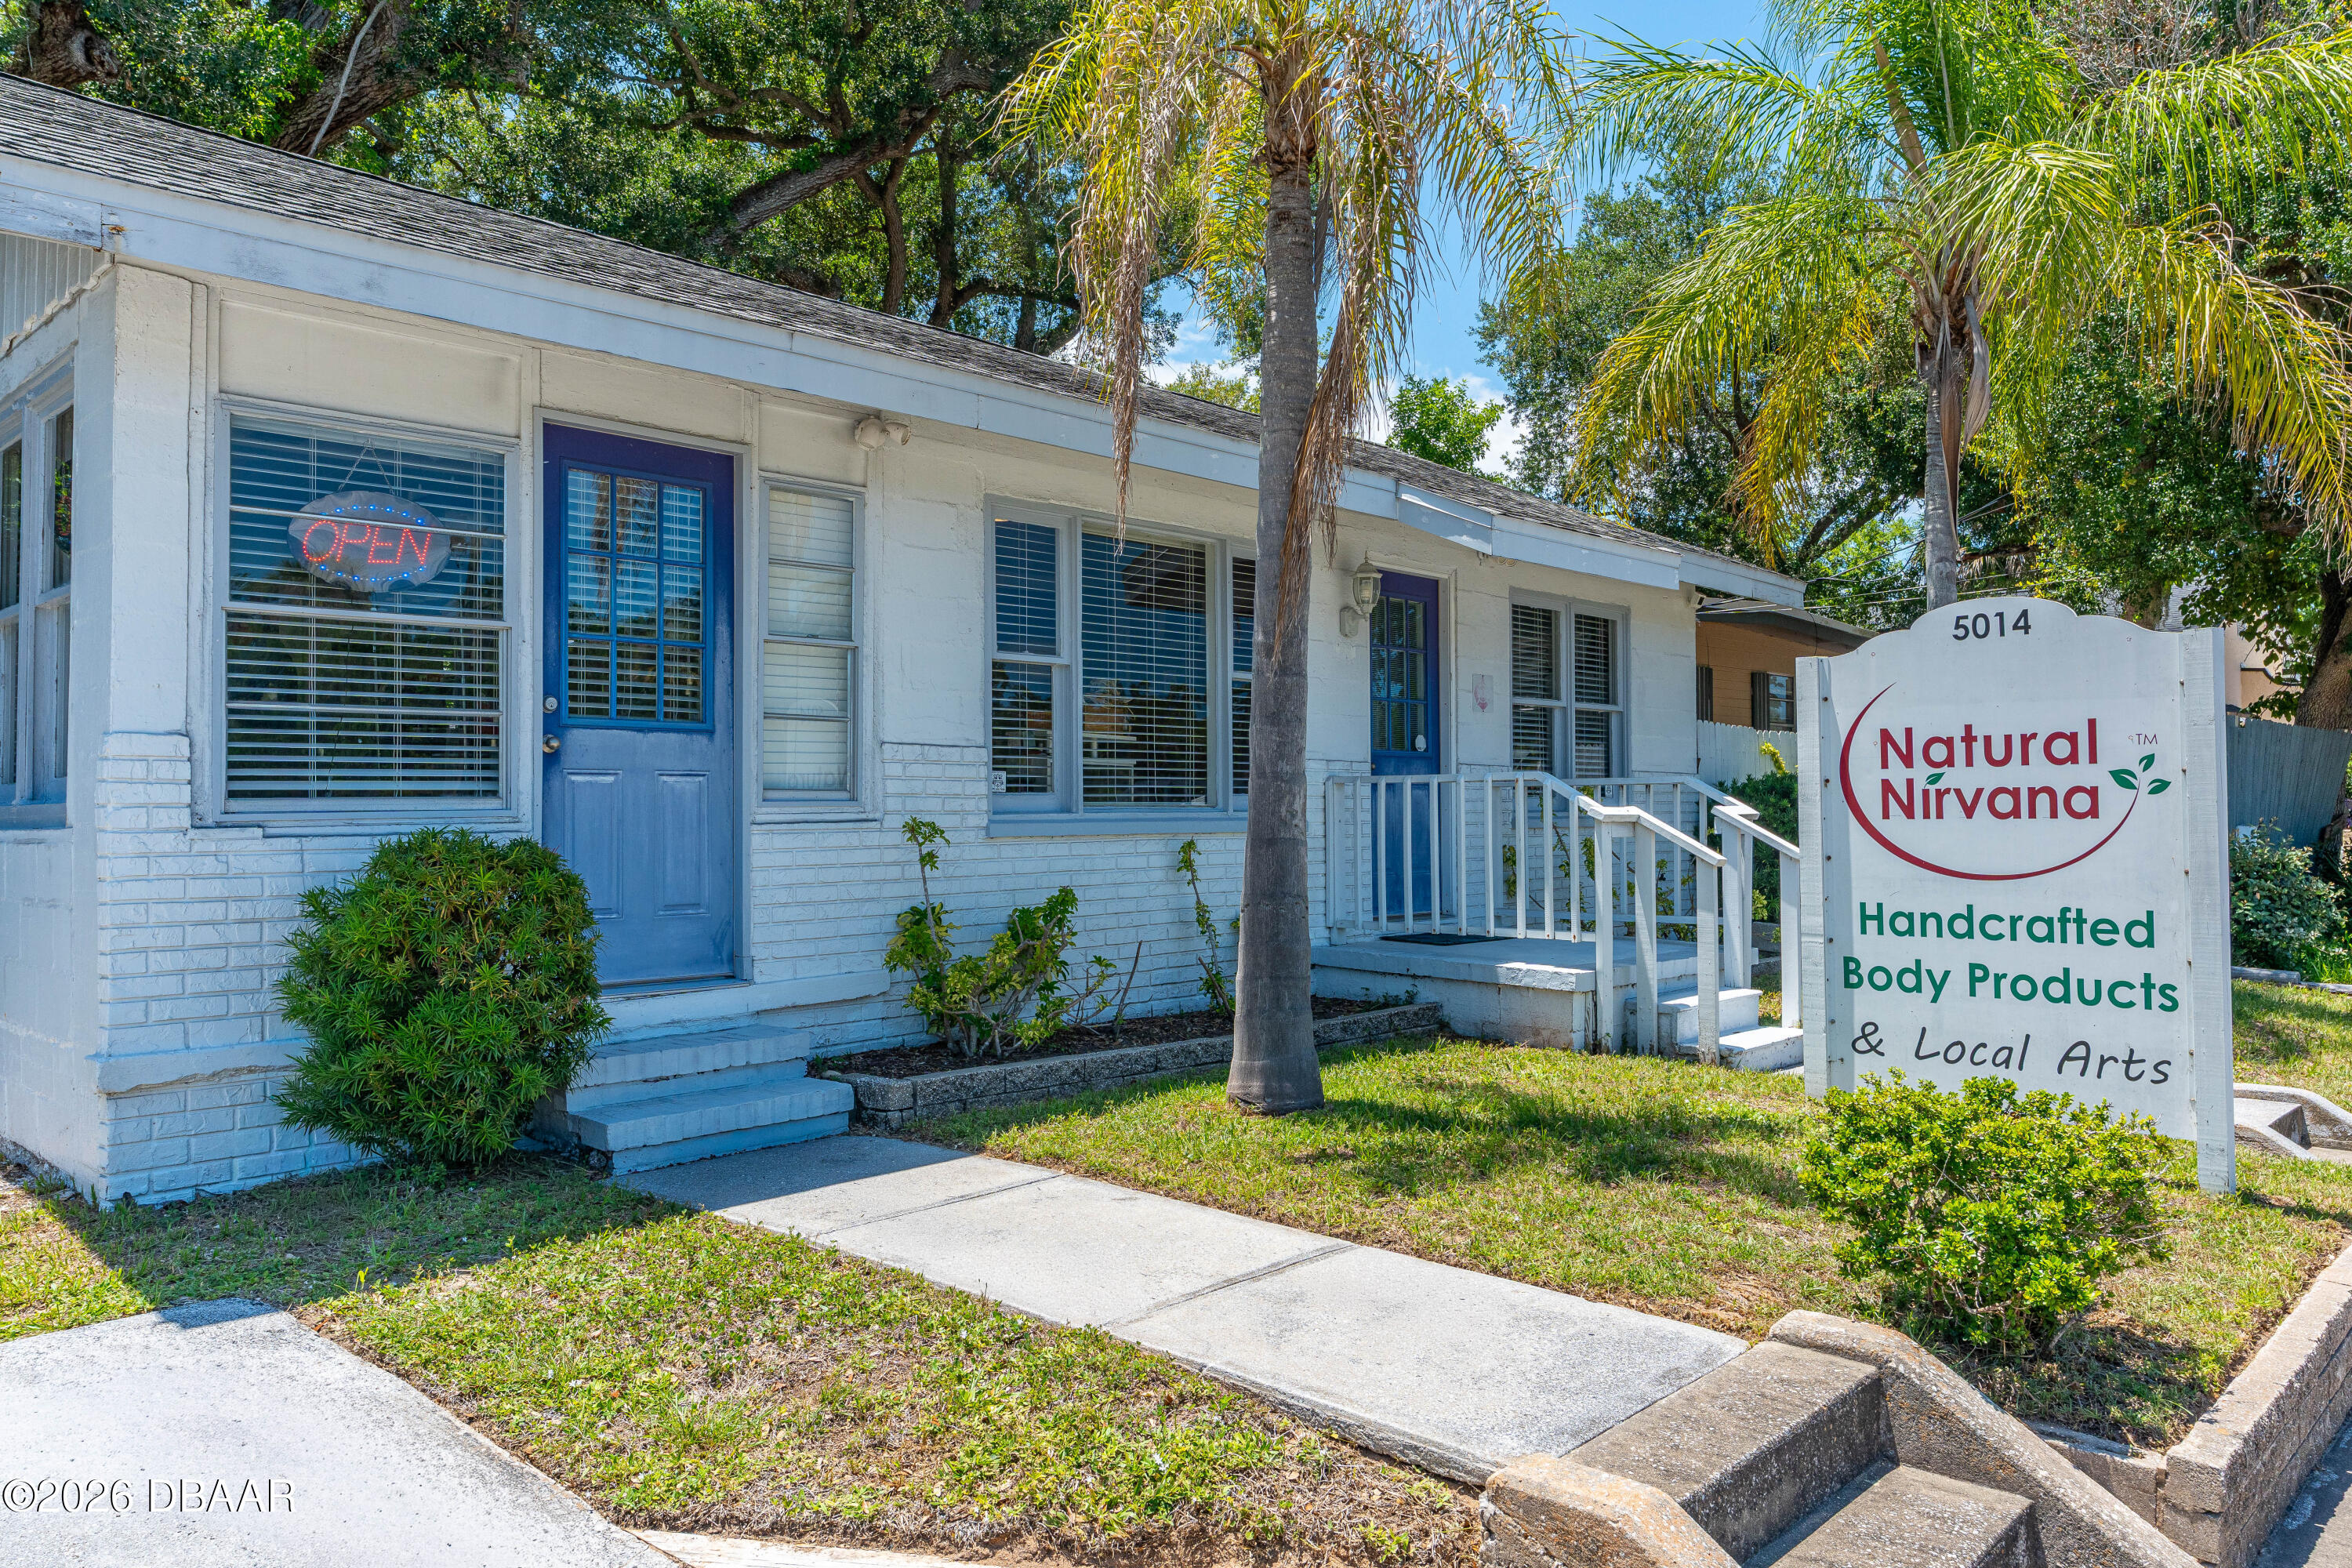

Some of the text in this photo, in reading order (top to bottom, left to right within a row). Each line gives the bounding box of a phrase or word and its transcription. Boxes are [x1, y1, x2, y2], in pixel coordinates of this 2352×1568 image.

[303, 519, 432, 564] OPEN
[1951, 608, 2032, 641] 5014
[1879, 717, 2098, 770] Natural
[1880, 776, 2100, 820] Nirvana
[1858, 901, 2155, 949] Handcrafted
[1842, 954, 2180, 1013] Body Products
[1850, 1020, 2172, 1085] & Local Arts
